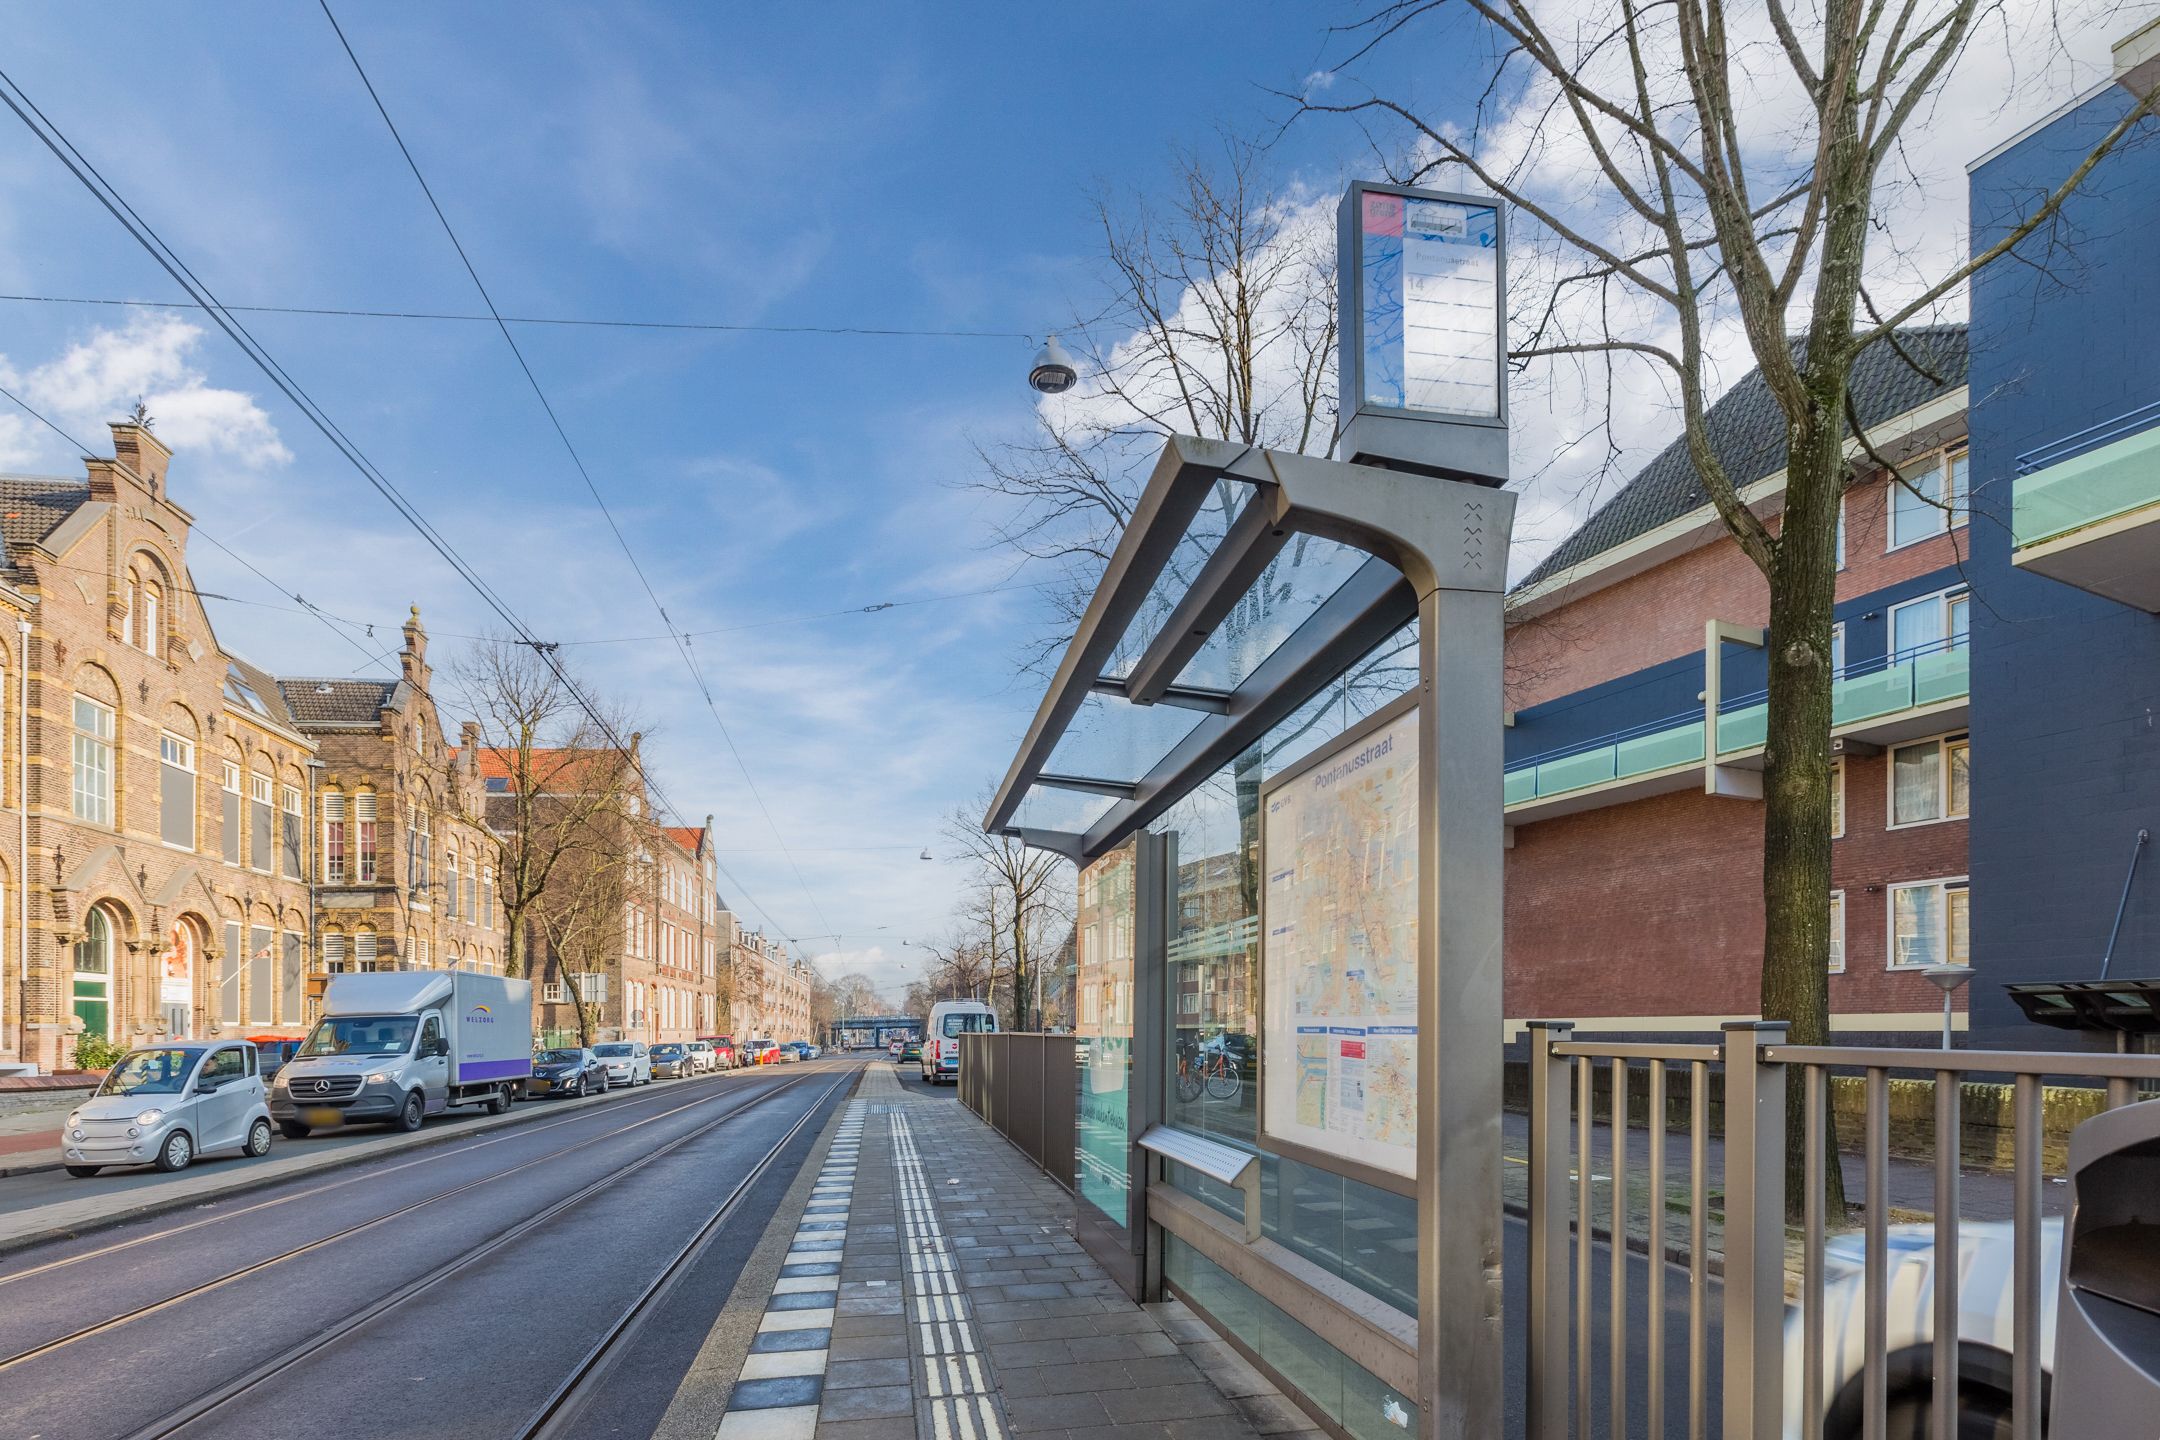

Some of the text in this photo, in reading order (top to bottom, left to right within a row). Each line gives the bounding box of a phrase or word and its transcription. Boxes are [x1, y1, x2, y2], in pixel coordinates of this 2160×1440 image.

[1408, 276, 1424, 290] 14
[1314, 733, 1393, 792] Pontanusstraat
[466, 1015, 494, 1023] WELZORG
